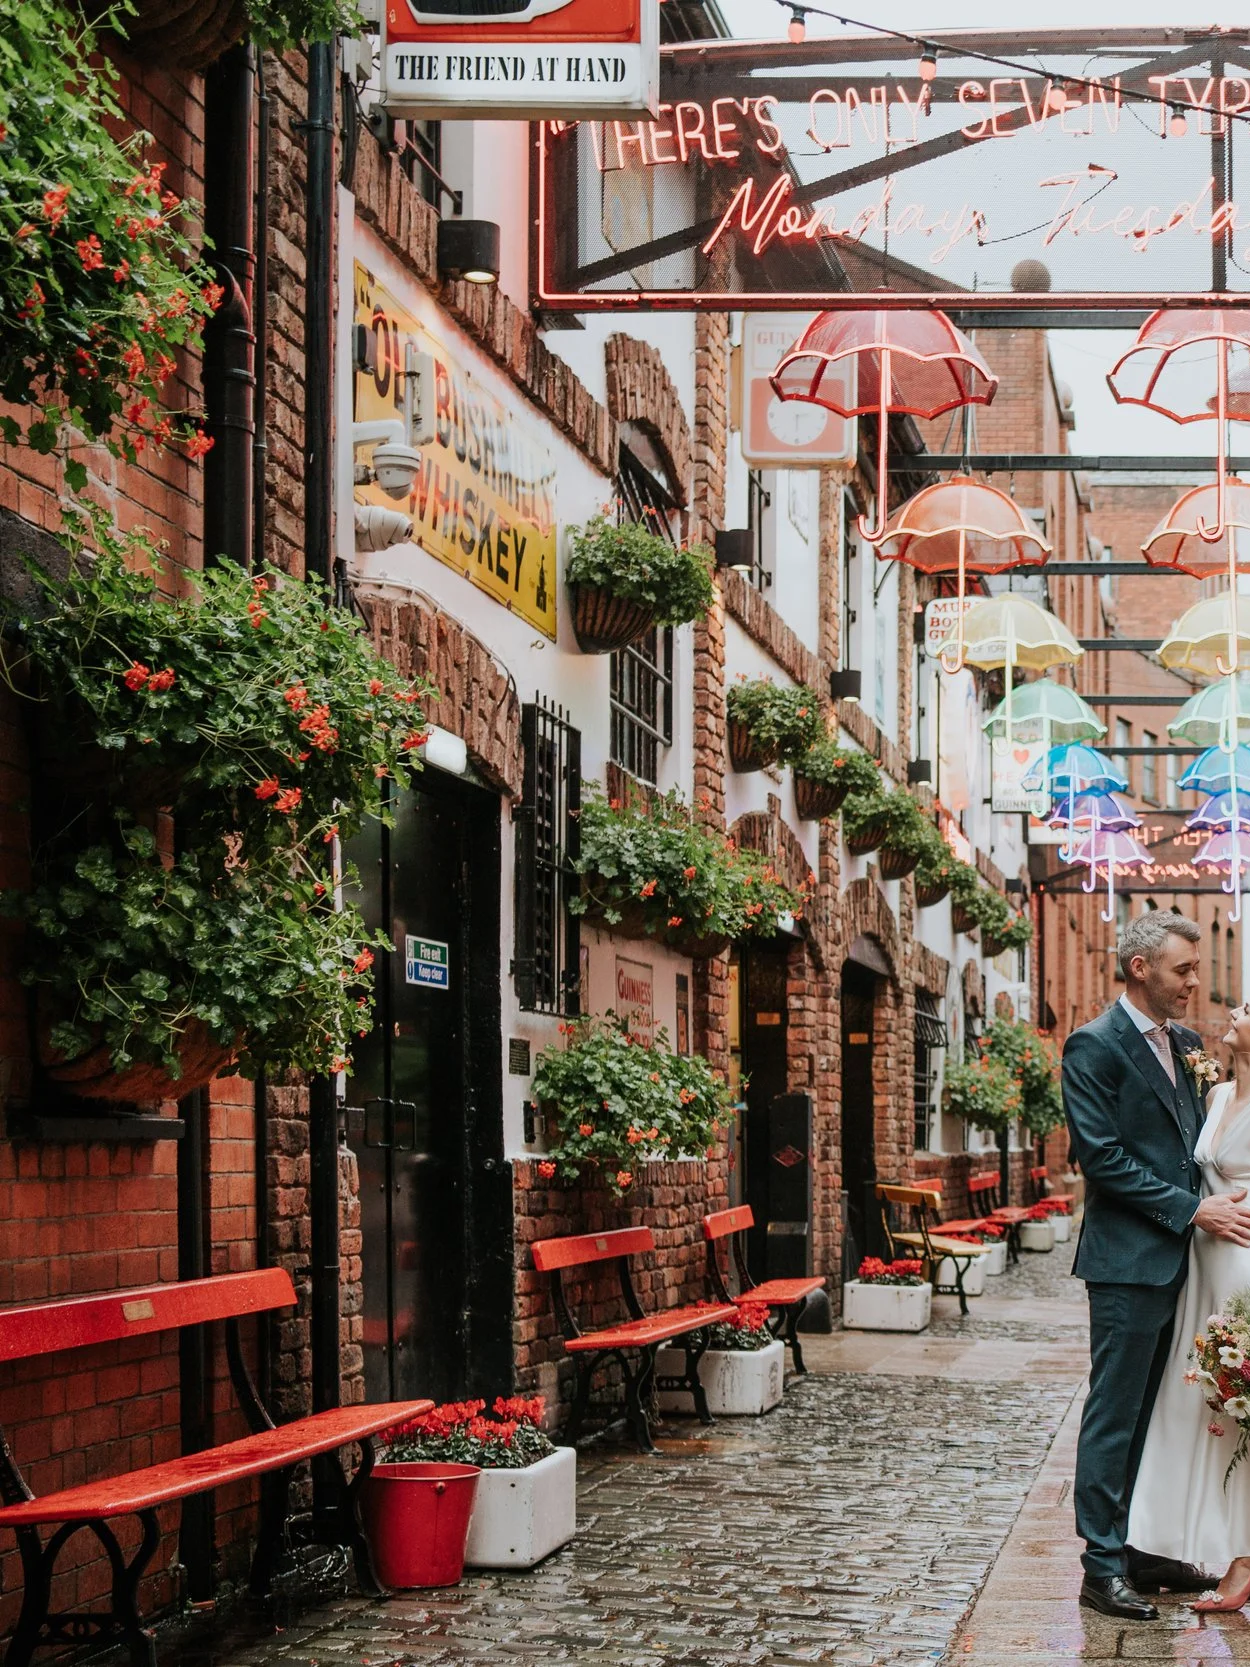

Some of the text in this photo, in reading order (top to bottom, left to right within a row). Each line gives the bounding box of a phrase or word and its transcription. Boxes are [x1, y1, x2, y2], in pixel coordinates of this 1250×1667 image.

[395, 55, 626, 82] THE FRIEND AT HAND
[809, 82, 928, 148] ONLY
[958, 77, 1120, 137] SEVEN
[410, 455, 528, 592] WHISKEY
[420, 944, 431, 960] Fire
[419, 964, 443, 982] Keep clear
